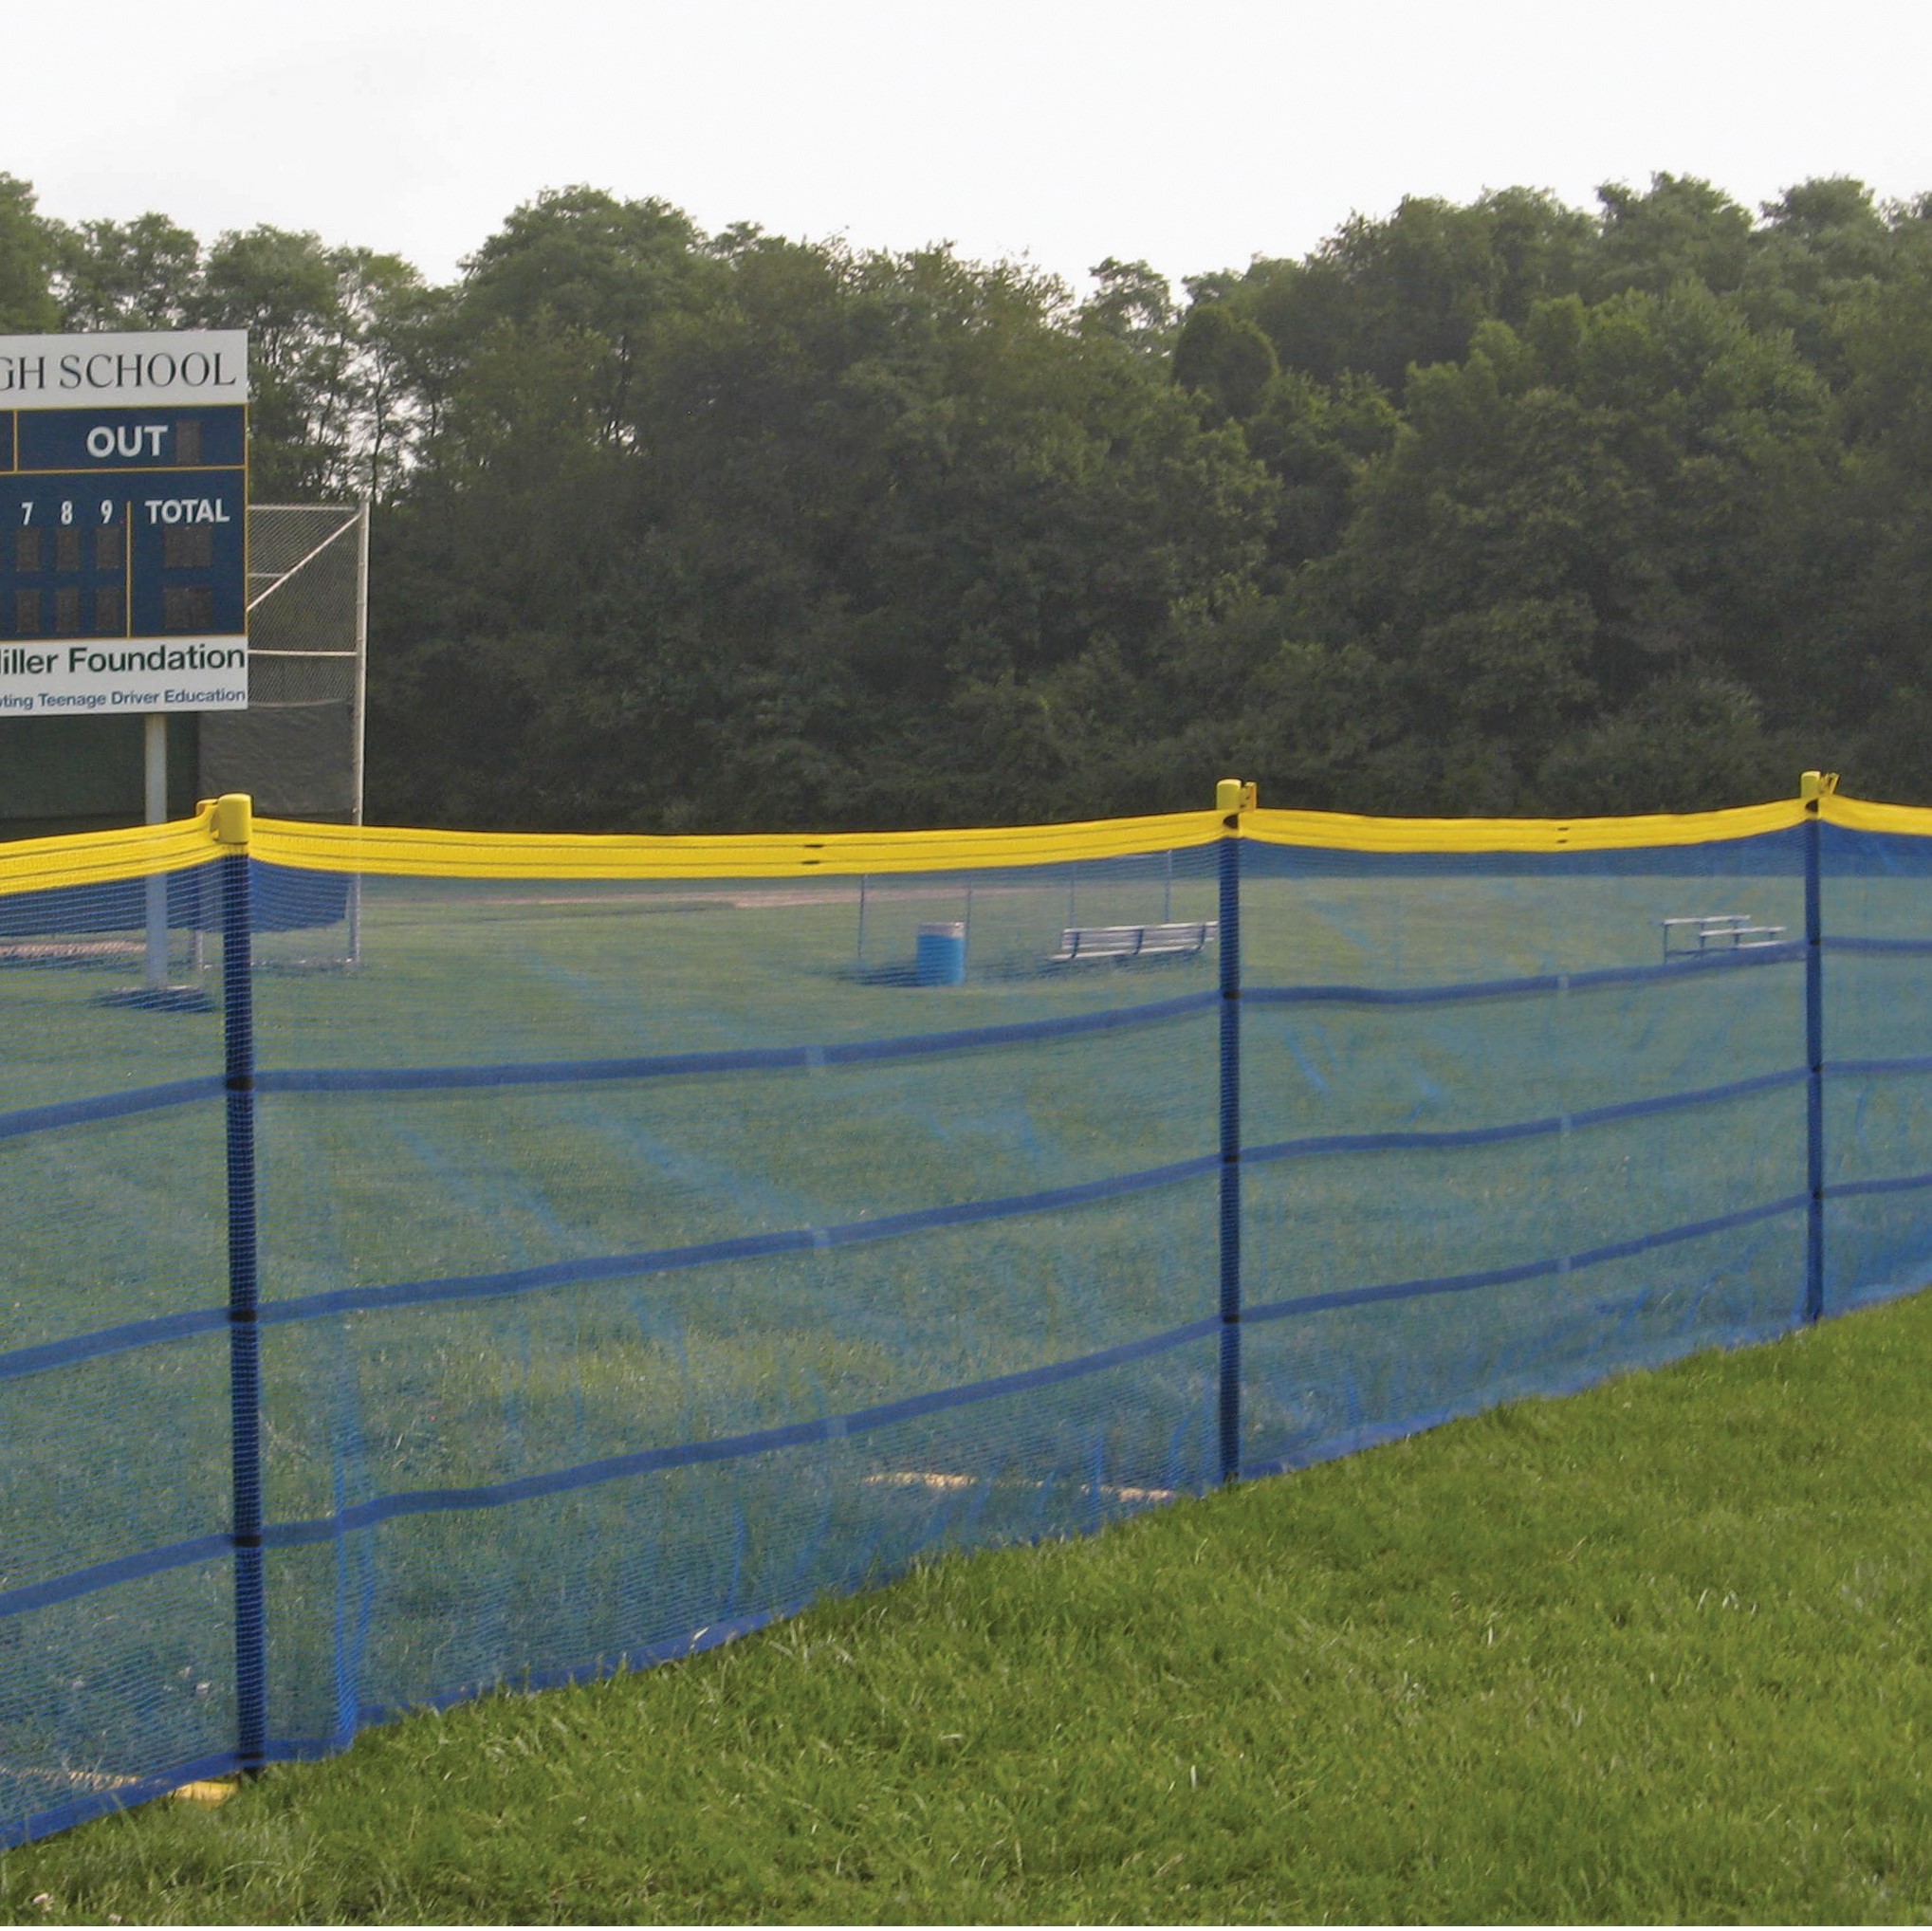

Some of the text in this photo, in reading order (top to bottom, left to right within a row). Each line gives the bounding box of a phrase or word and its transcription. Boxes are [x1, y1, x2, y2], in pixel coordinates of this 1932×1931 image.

[59, 352, 237, 390] SCHOOL
[86, 425, 169, 458] OUT
[21, 498, 230, 525] 7 8 9 TOTAL
[0, 643, 245, 675] iller Foundation
[38, 692, 106, 709] Teenage
[111, 690, 159, 705] Driver
[164, 687, 246, 704] Education
